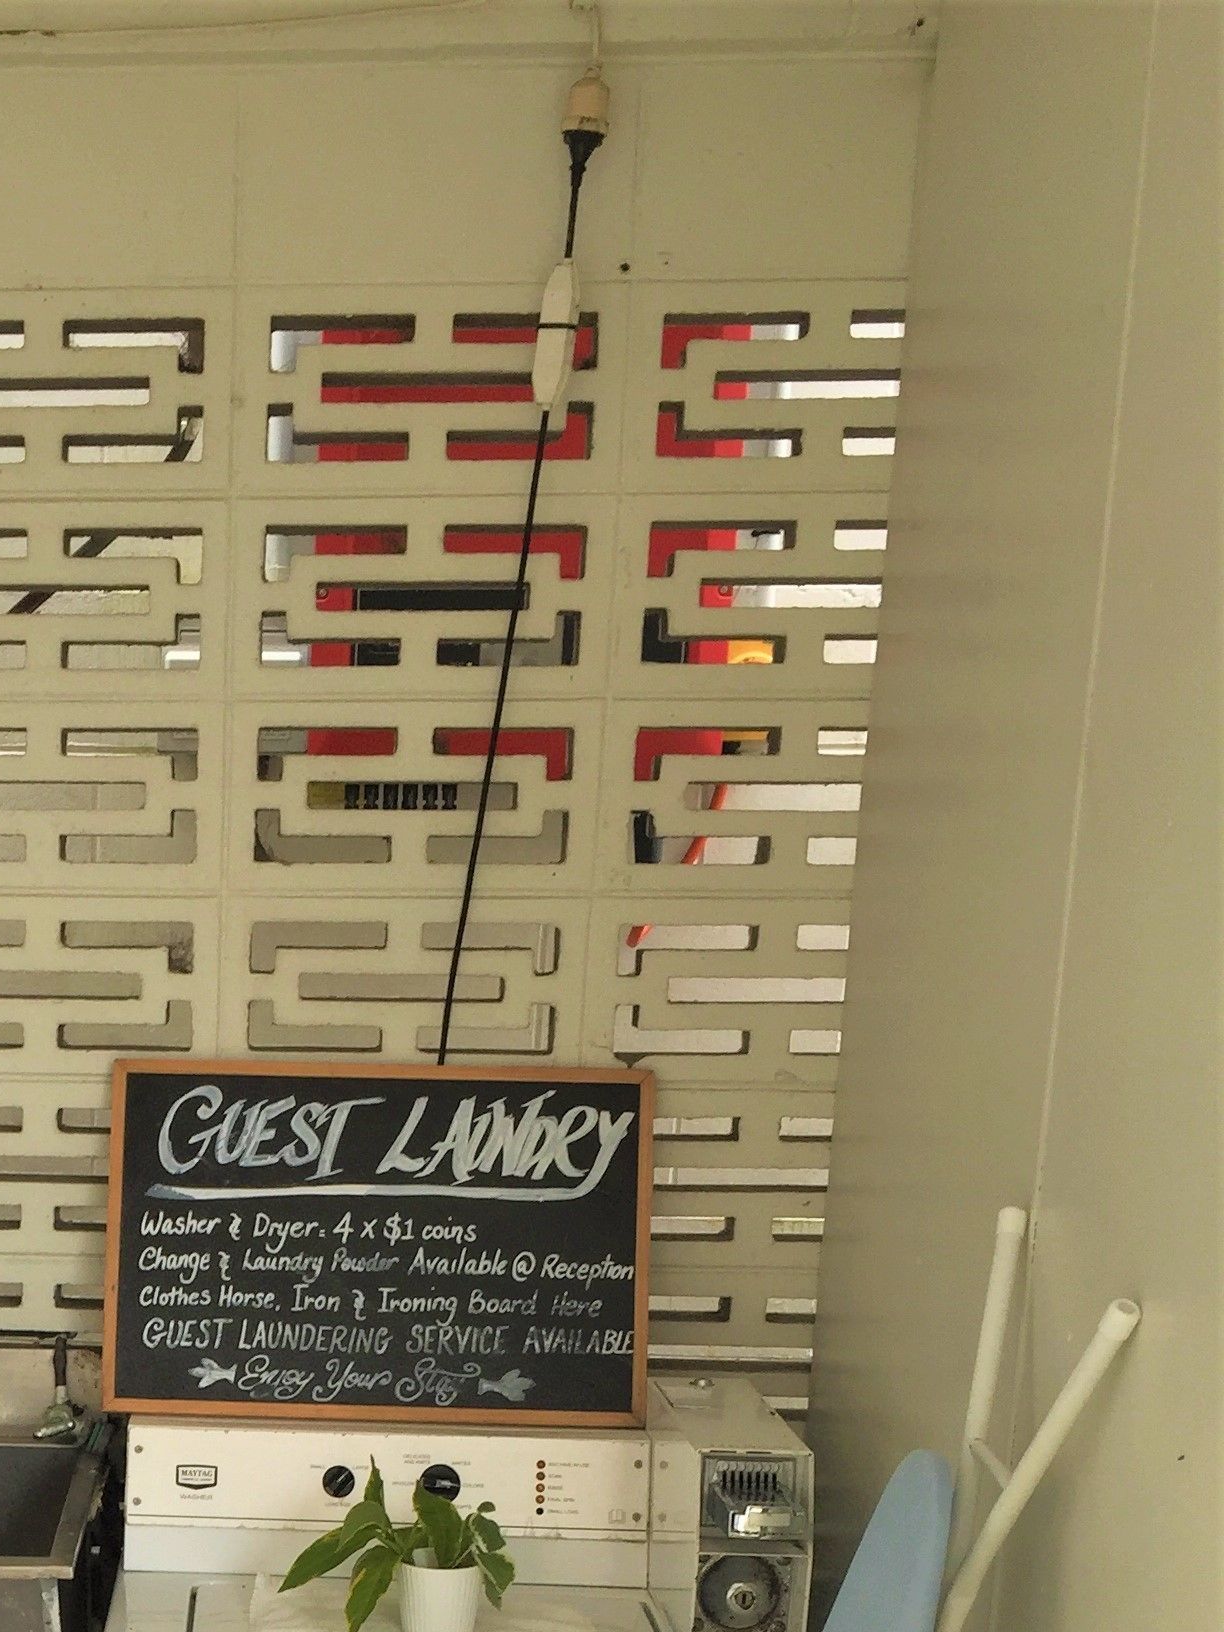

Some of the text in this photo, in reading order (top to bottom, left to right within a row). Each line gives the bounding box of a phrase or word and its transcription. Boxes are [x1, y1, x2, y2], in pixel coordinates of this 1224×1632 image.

[158, 1085, 636, 1186] GUEST LAUNDRY
[140, 1210, 222, 1237] Washer
[332, 1212, 354, 1244] 4
[383, 1212, 415, 1246] $1
[421, 1216, 478, 1244] coins
[138, 1246, 211, 1285] Change
[241, 1248, 325, 1284] Laundry
[330, 1247, 401, 1273] Powder
[407, 1247, 507, 1277] Available
[511, 1251, 537, 1282] @
[540, 1254, 637, 1291] Reception
[139, 1285, 212, 1308] Clothes
[290, 1283, 342, 1313] Iron
[376, 1286, 459, 1327] Ironing
[467, 1288, 538, 1316] Board
[550, 1290, 604, 1318] Here
[142, 1317, 636, 1356] GUEST LAUNDERING SERVICE AVAILABLE
[237, 1354, 483, 1407] Enjoy Your Stay
[181, 1469, 214, 1478] MAYTAG
